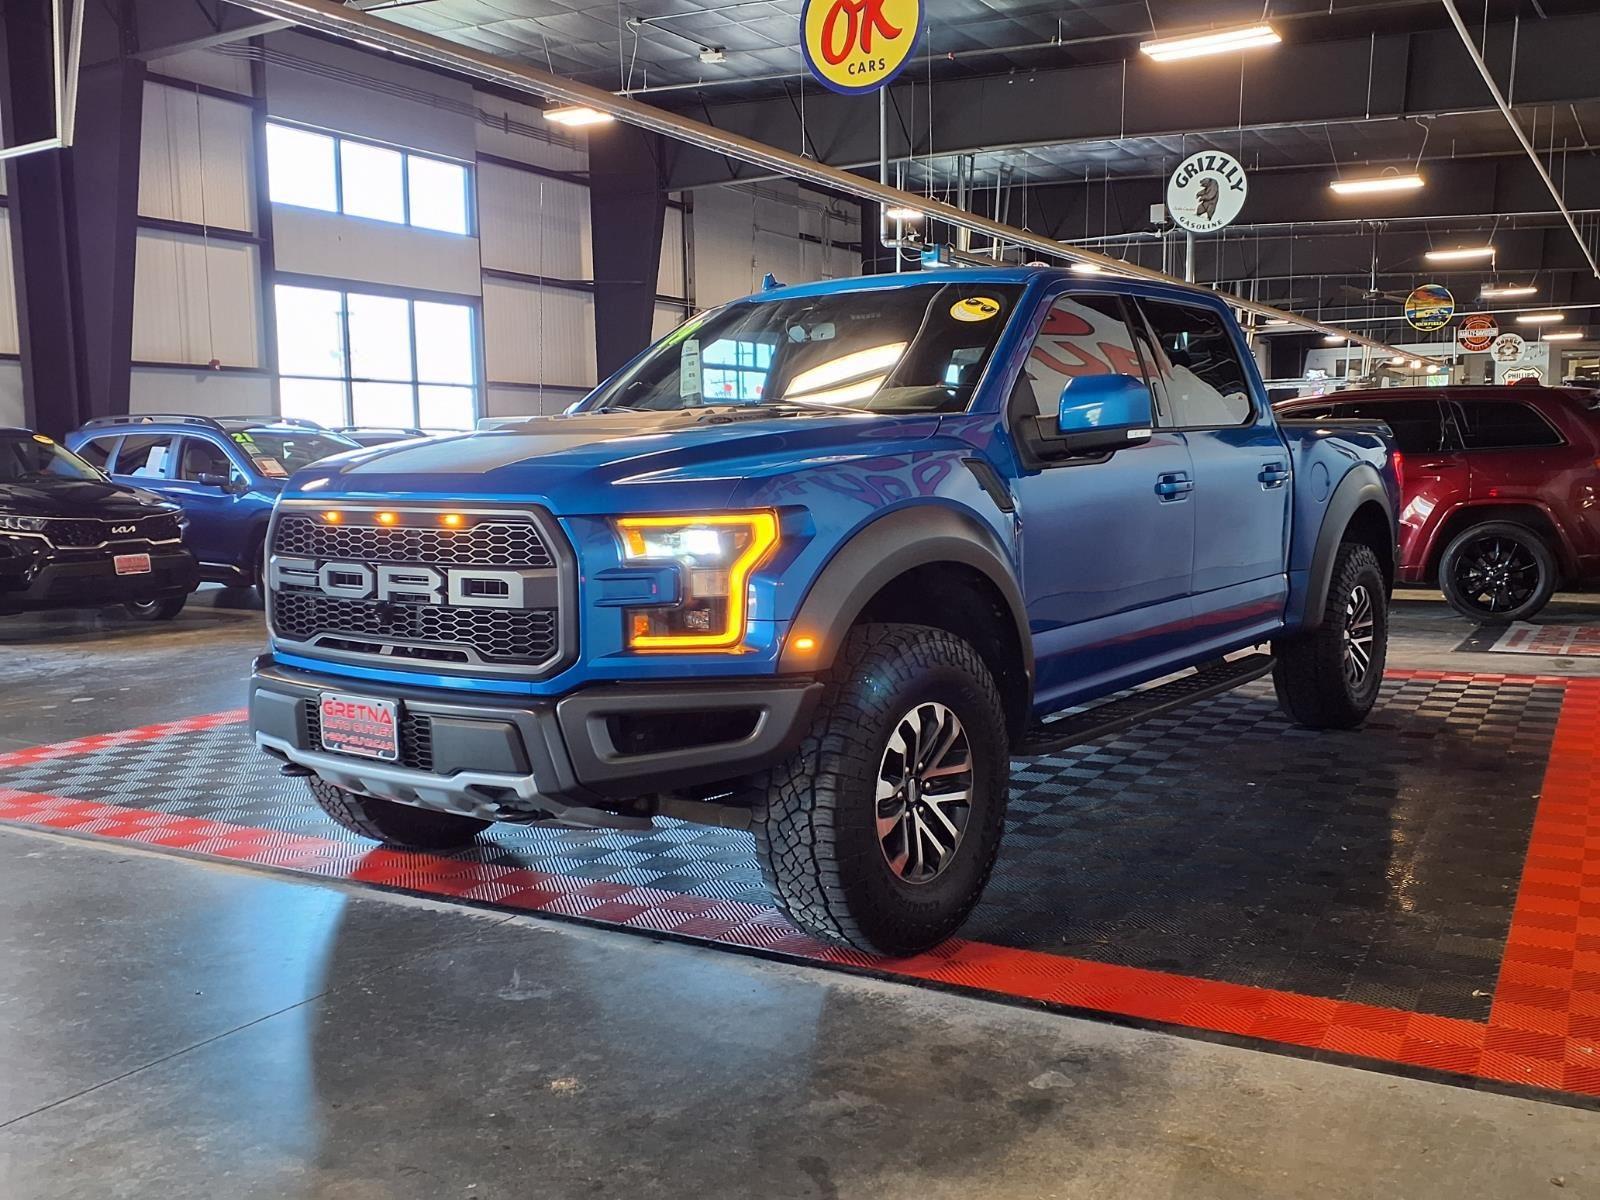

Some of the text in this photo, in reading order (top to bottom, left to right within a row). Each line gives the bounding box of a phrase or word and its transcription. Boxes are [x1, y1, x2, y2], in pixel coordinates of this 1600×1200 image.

[820, 0, 903, 66] OK
[847, 58, 886, 75] CARS
[1175, 155, 1244, 192] GRIZZLY
[1179, 216, 1223, 230] GASOLINE
[270, 555, 524, 609] FORD
[323, 701, 393, 725] GRETNA
